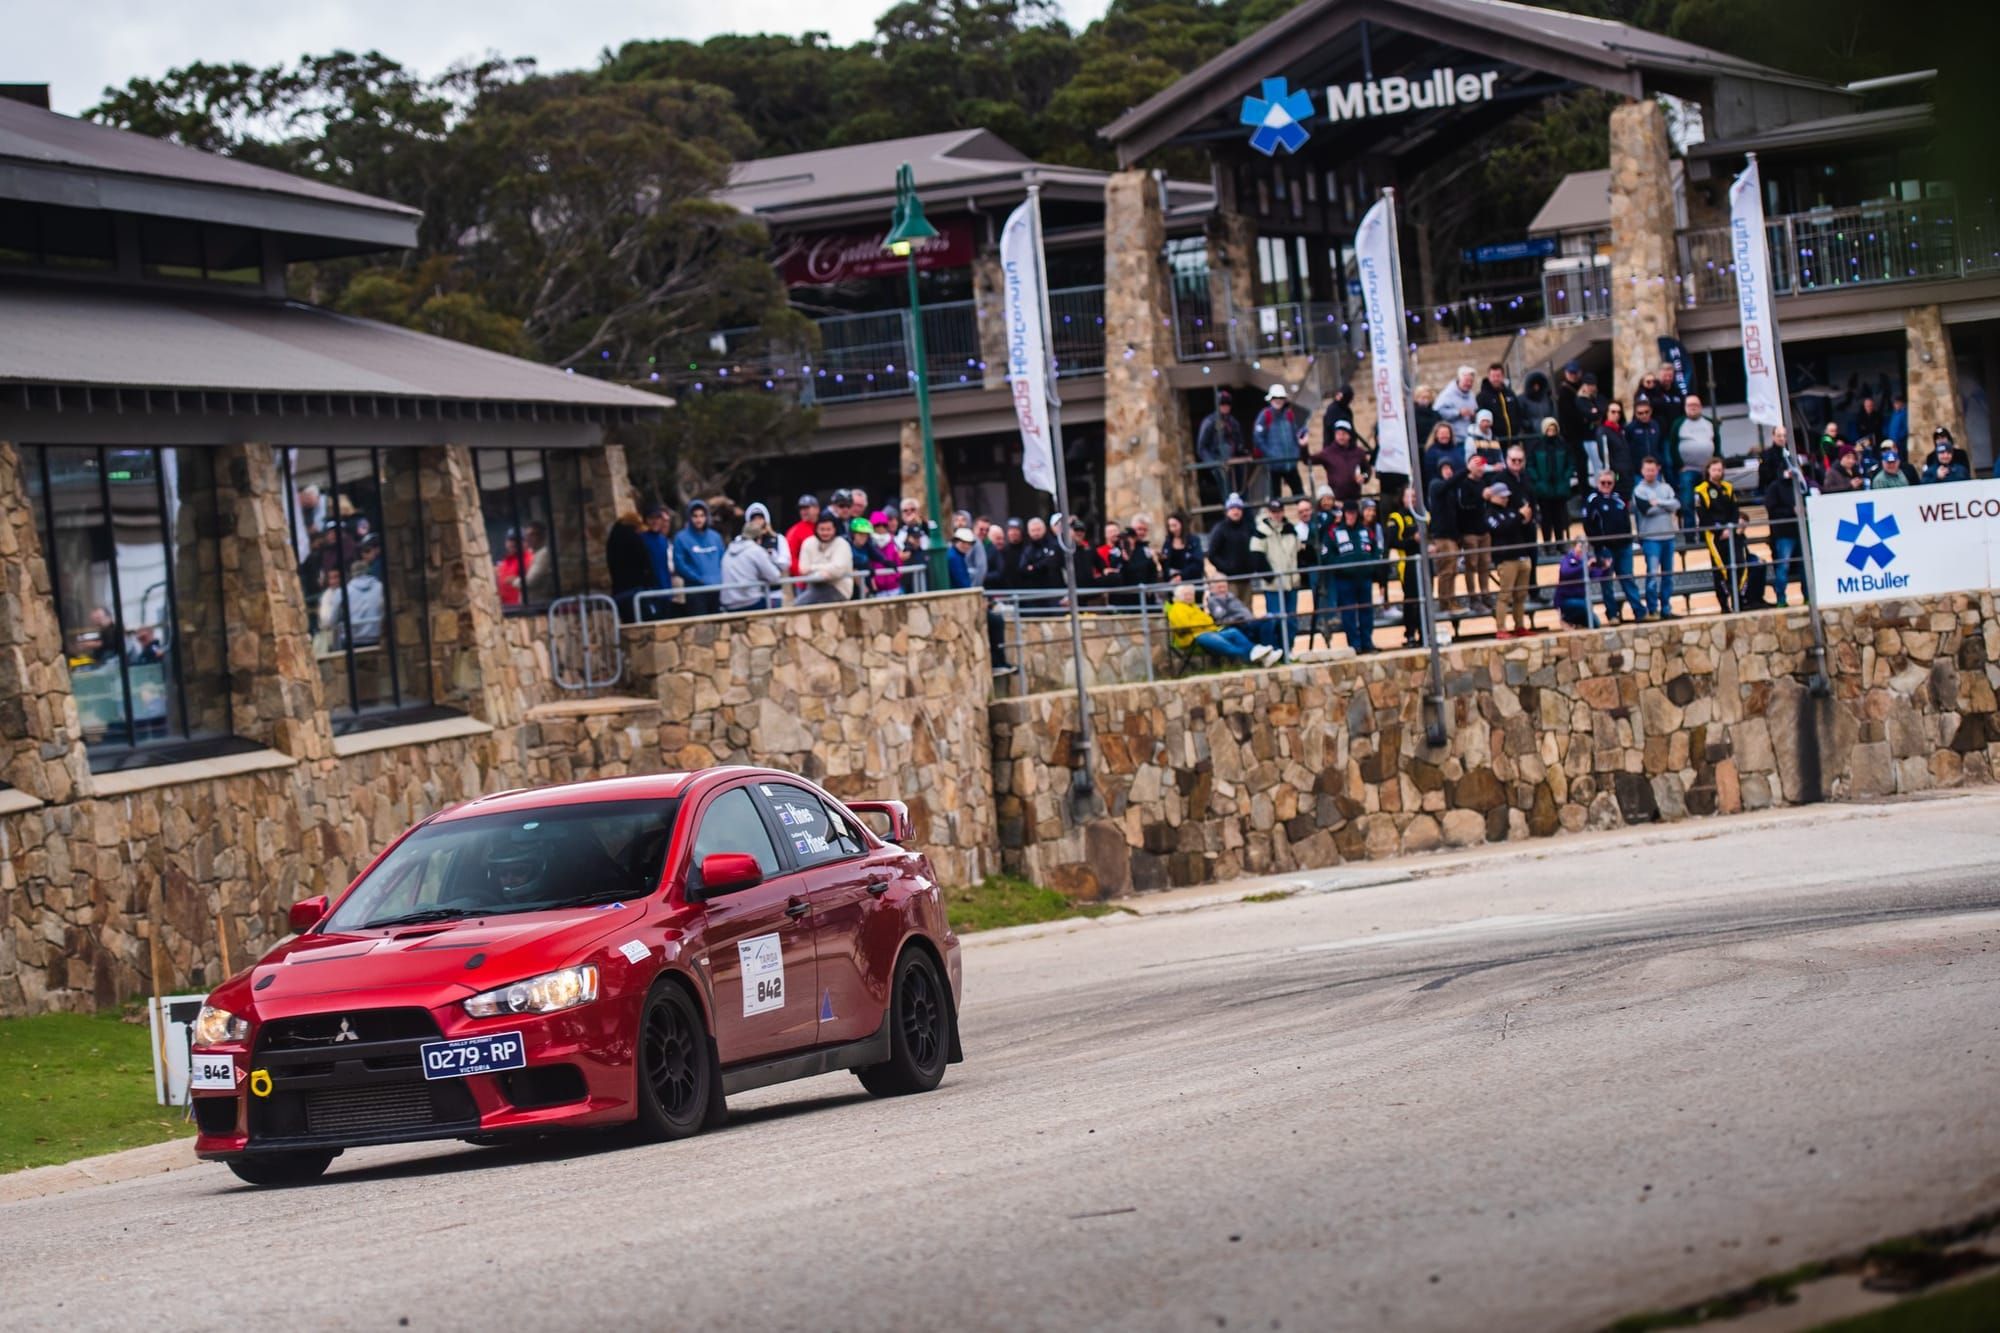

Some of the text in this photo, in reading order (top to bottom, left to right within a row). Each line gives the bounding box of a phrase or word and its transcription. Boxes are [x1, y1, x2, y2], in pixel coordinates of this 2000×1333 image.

[1919, 499, 2000, 523] WELCO
[758, 977, 782, 1003] 842
[203, 1064, 230, 1080] 842
[459, 1064, 491, 1074] VICTORIA
